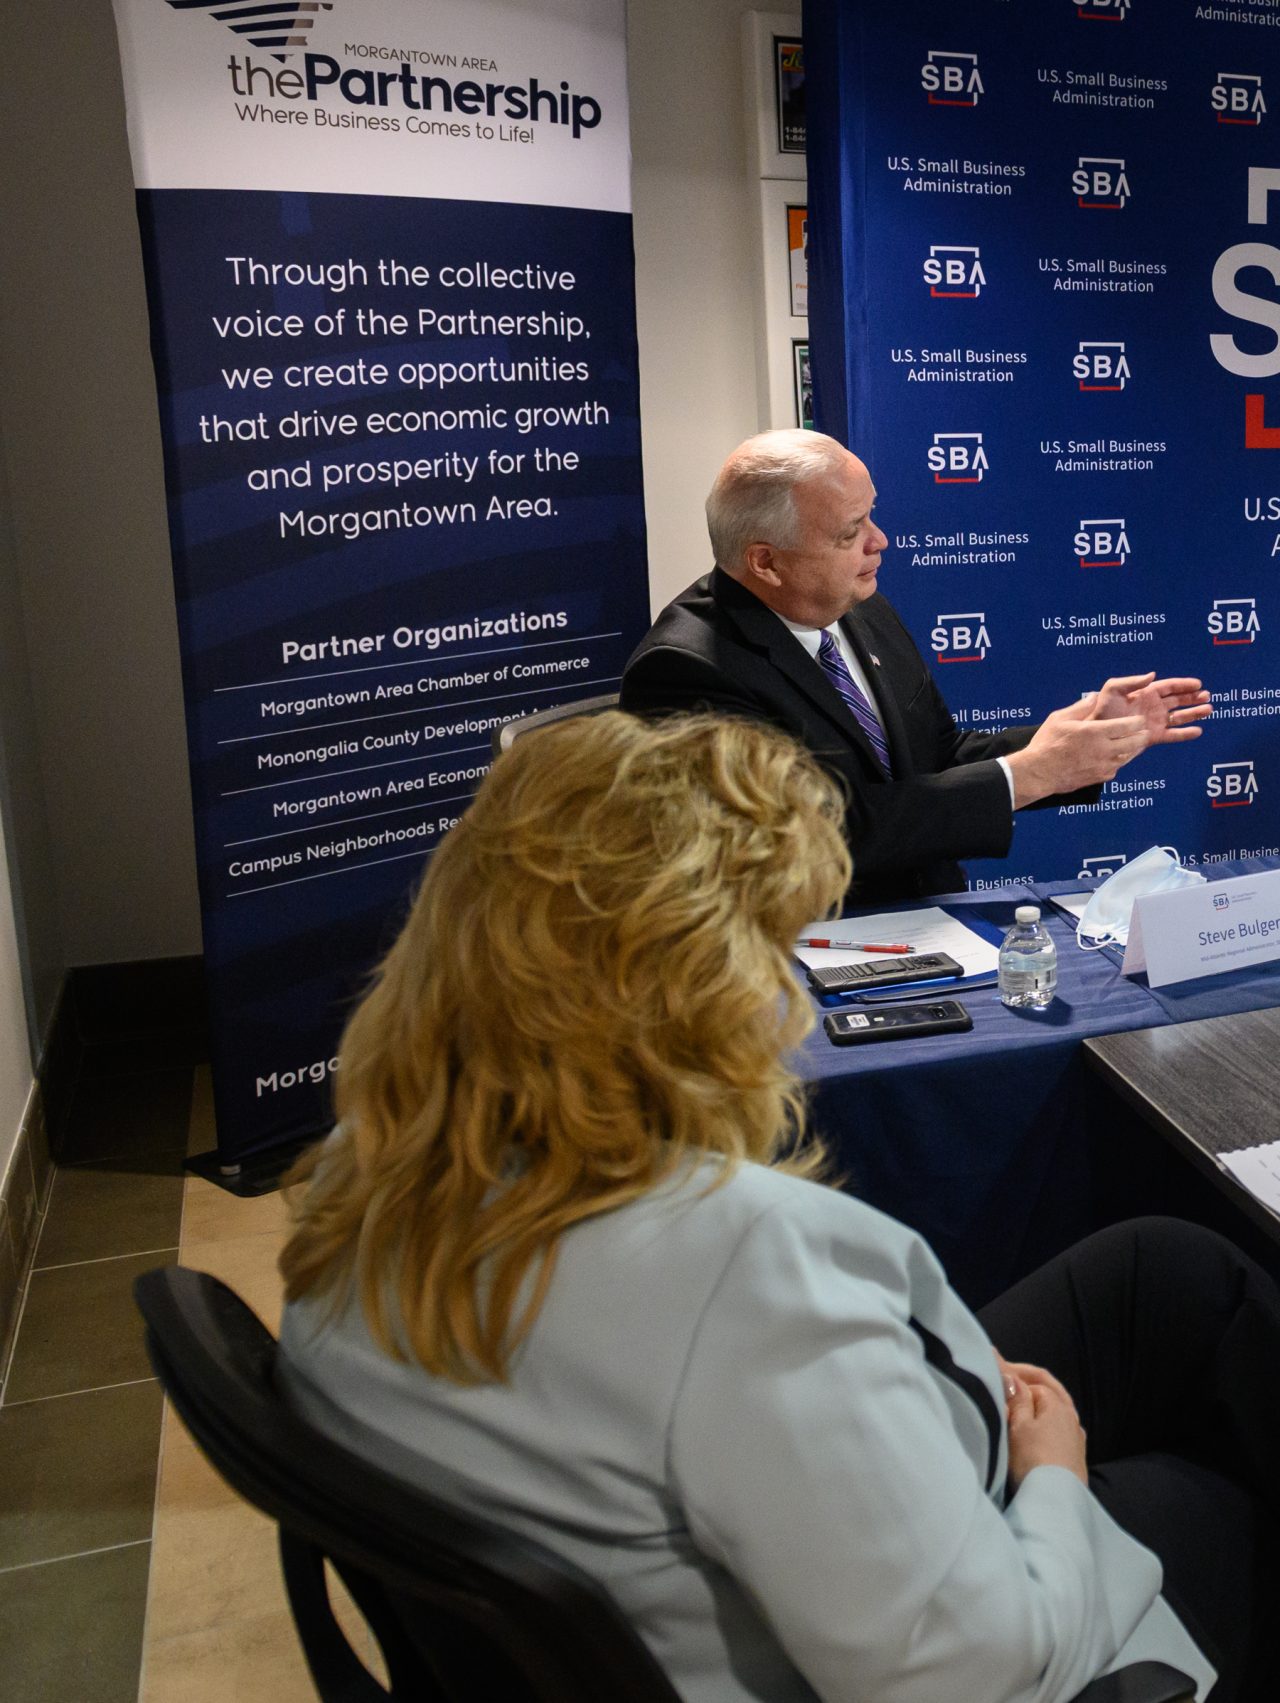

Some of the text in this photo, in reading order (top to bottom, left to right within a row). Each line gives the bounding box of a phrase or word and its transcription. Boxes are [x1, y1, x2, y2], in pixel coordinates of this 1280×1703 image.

[344, 43, 498, 72] MORGANTOWN AREA
[921, 64, 984, 94] SBA
[1038, 69, 1168, 90] U.S. Small Business
[1052, 90, 1154, 108] Administration
[1211, 85, 1267, 113] SBA
[234, 102, 534, 144] Where Business Comes to Life!
[888, 156, 1025, 176] U.S. Small Business
[904, 177, 1011, 195] Administration
[1072, 170, 1131, 197] SBA
[225, 257, 575, 292] Through the collective
[923, 258, 986, 285] SBA
[1039, 258, 1166, 274] U.S. Small Business
[1054, 277, 1154, 292] Administration
[212, 308, 590, 342] voice of the Partnership,
[892, 349, 1027, 363] U.S. Small Business
[1072, 354, 1131, 379] SBA
[222, 357, 588, 390] we create opportunities
[907, 368, 1013, 382] Administration
[199, 401, 609, 442] that drive economic growth
[928, 446, 989, 471] SBA
[1040, 440, 1166, 454] U.S. Small Business
[248, 448, 579, 492] and prosperity for the
[1055, 458, 1153, 471] Administration
[280, 496, 558, 539] Morgantown Area.
[896, 532, 1029, 548] U.S. Small Business
[1074, 532, 1131, 556] SBA
[912, 550, 1015, 566] Administration
[1042, 612, 1166, 630] U.S. Small Business
[1207, 611, 1261, 635] SBA
[282, 612, 568, 664] Partner Organizations
[931, 627, 992, 652] SBA
[1056, 630, 1153, 646] Administration
[261, 658, 590, 717] Morgantown Area Chamber of Commerce
[258, 740, 358, 769] Monongalia
[363, 730, 420, 750] County
[273, 787, 382, 817] Morgantown
[386, 778, 424, 795] Area
[1207, 773, 1259, 798] SBA
[229, 852, 302, 876] Campus
[307, 822, 435, 860] Neighborhoods
[1198, 918, 1280, 946] Steve Bulger
